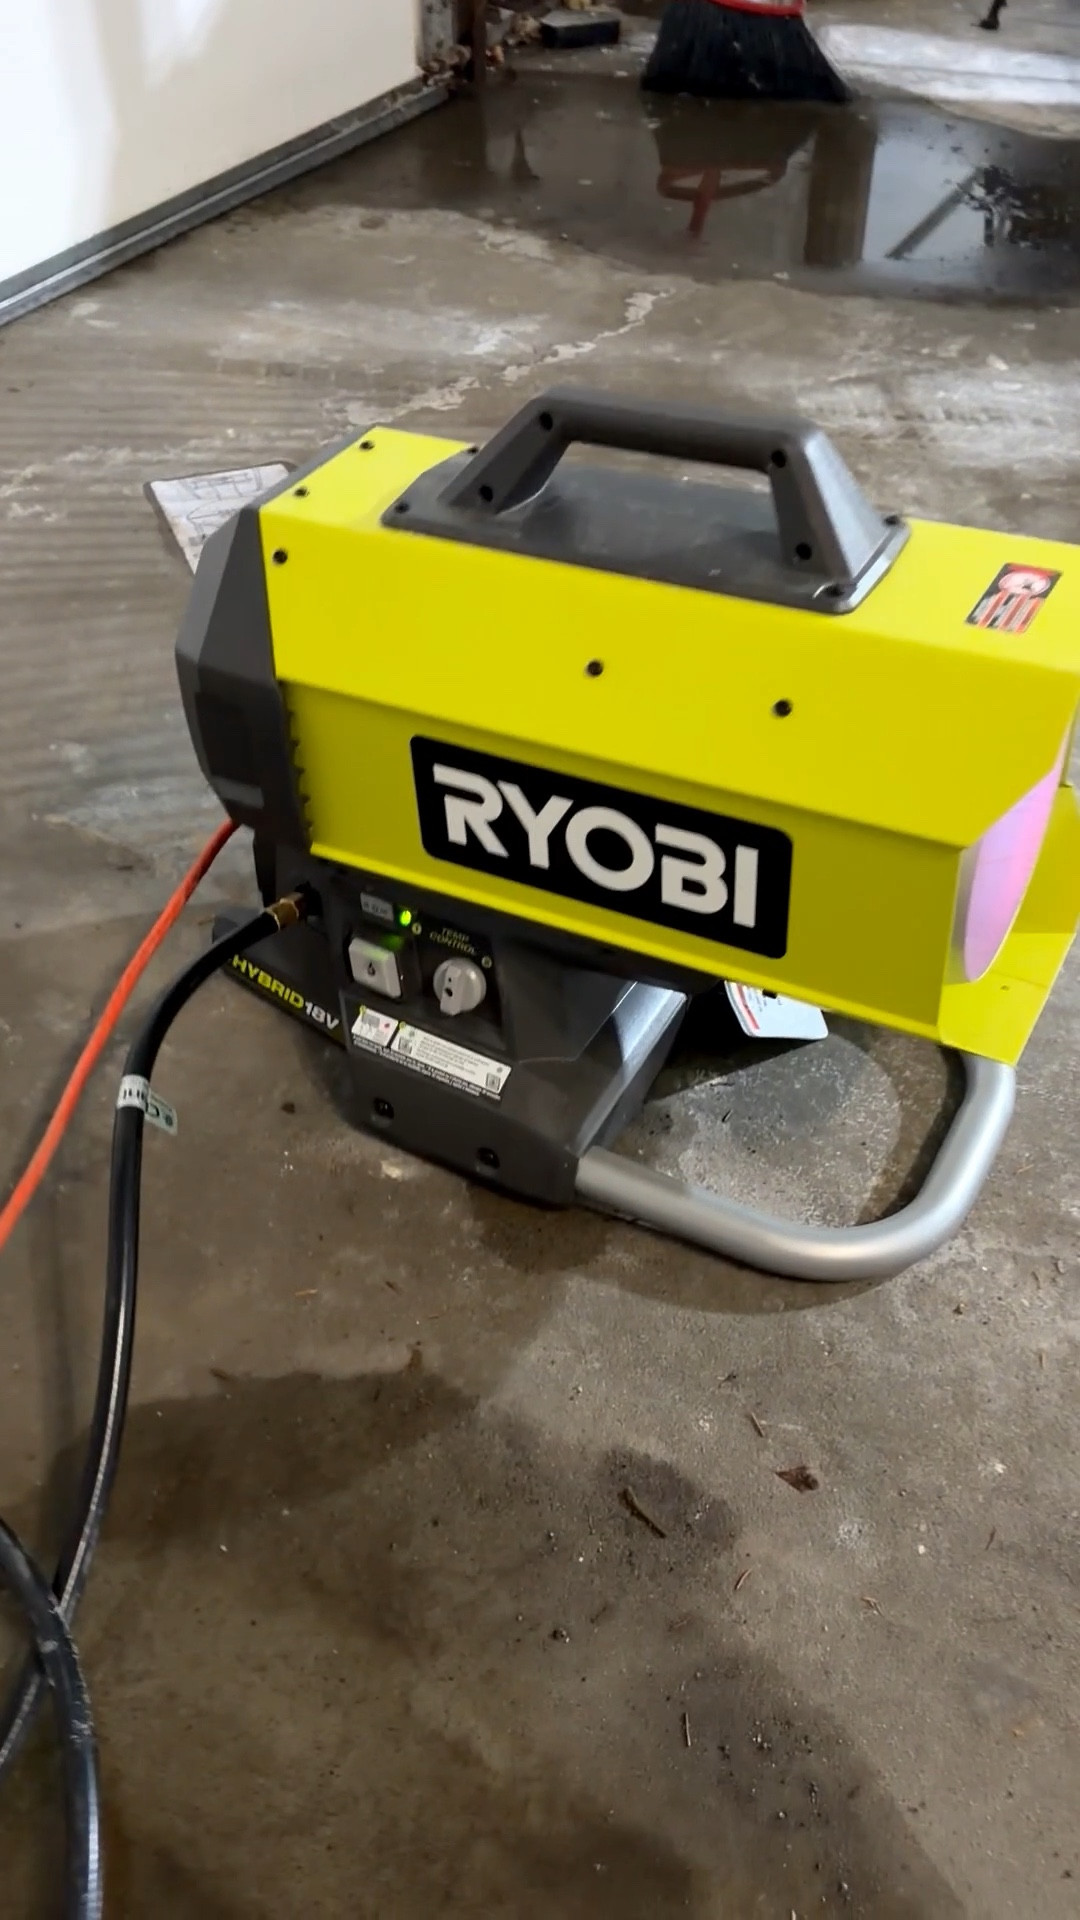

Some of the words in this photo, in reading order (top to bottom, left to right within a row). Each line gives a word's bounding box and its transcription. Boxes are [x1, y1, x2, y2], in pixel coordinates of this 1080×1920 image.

[433, 762, 759, 929] RYOBI
[429, 930, 477, 956] CONTROL
[441, 927, 470, 943] TEMP
